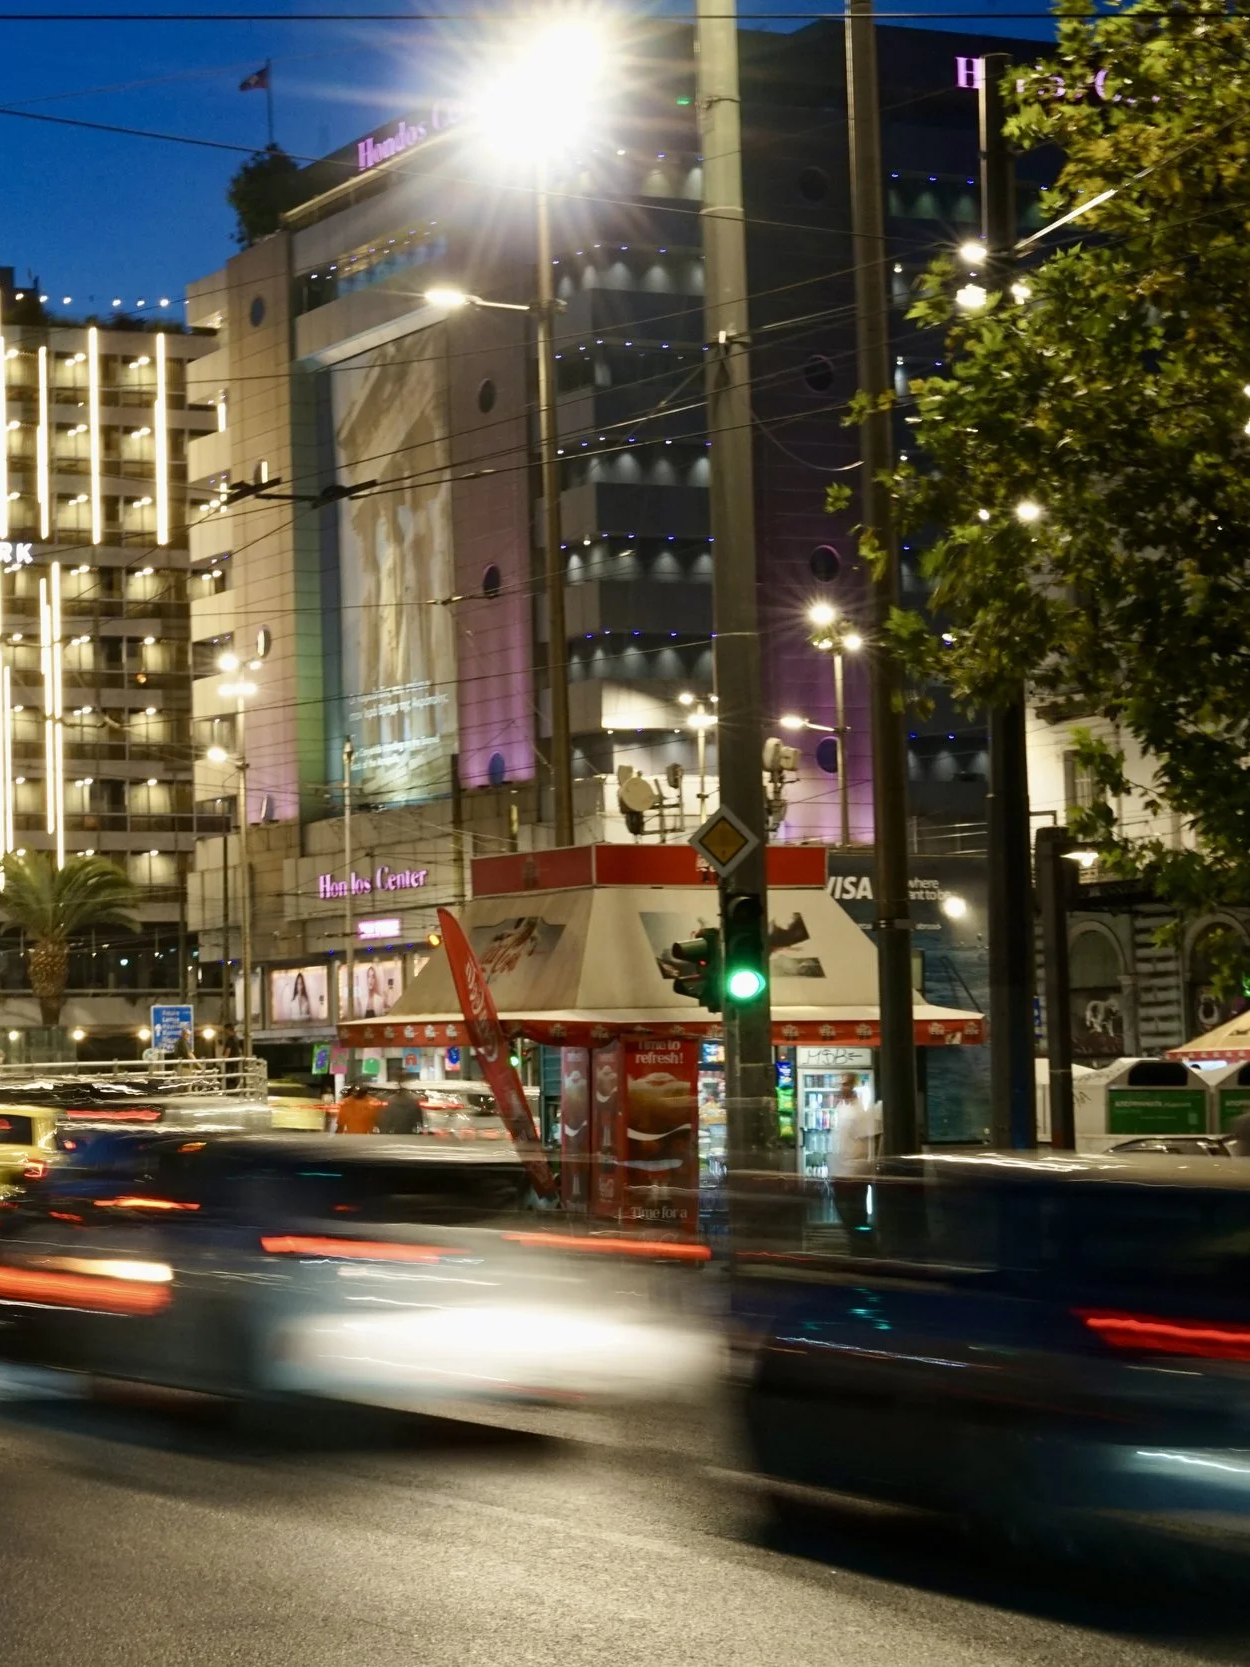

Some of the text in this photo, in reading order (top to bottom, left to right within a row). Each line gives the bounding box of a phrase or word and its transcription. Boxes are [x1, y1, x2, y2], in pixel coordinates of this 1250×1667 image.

[375, 865, 428, 891] Center
[826, 876, 874, 900] VISA
[667, 1039, 681, 1051] to
[635, 1051, 684, 1064] refresh!
